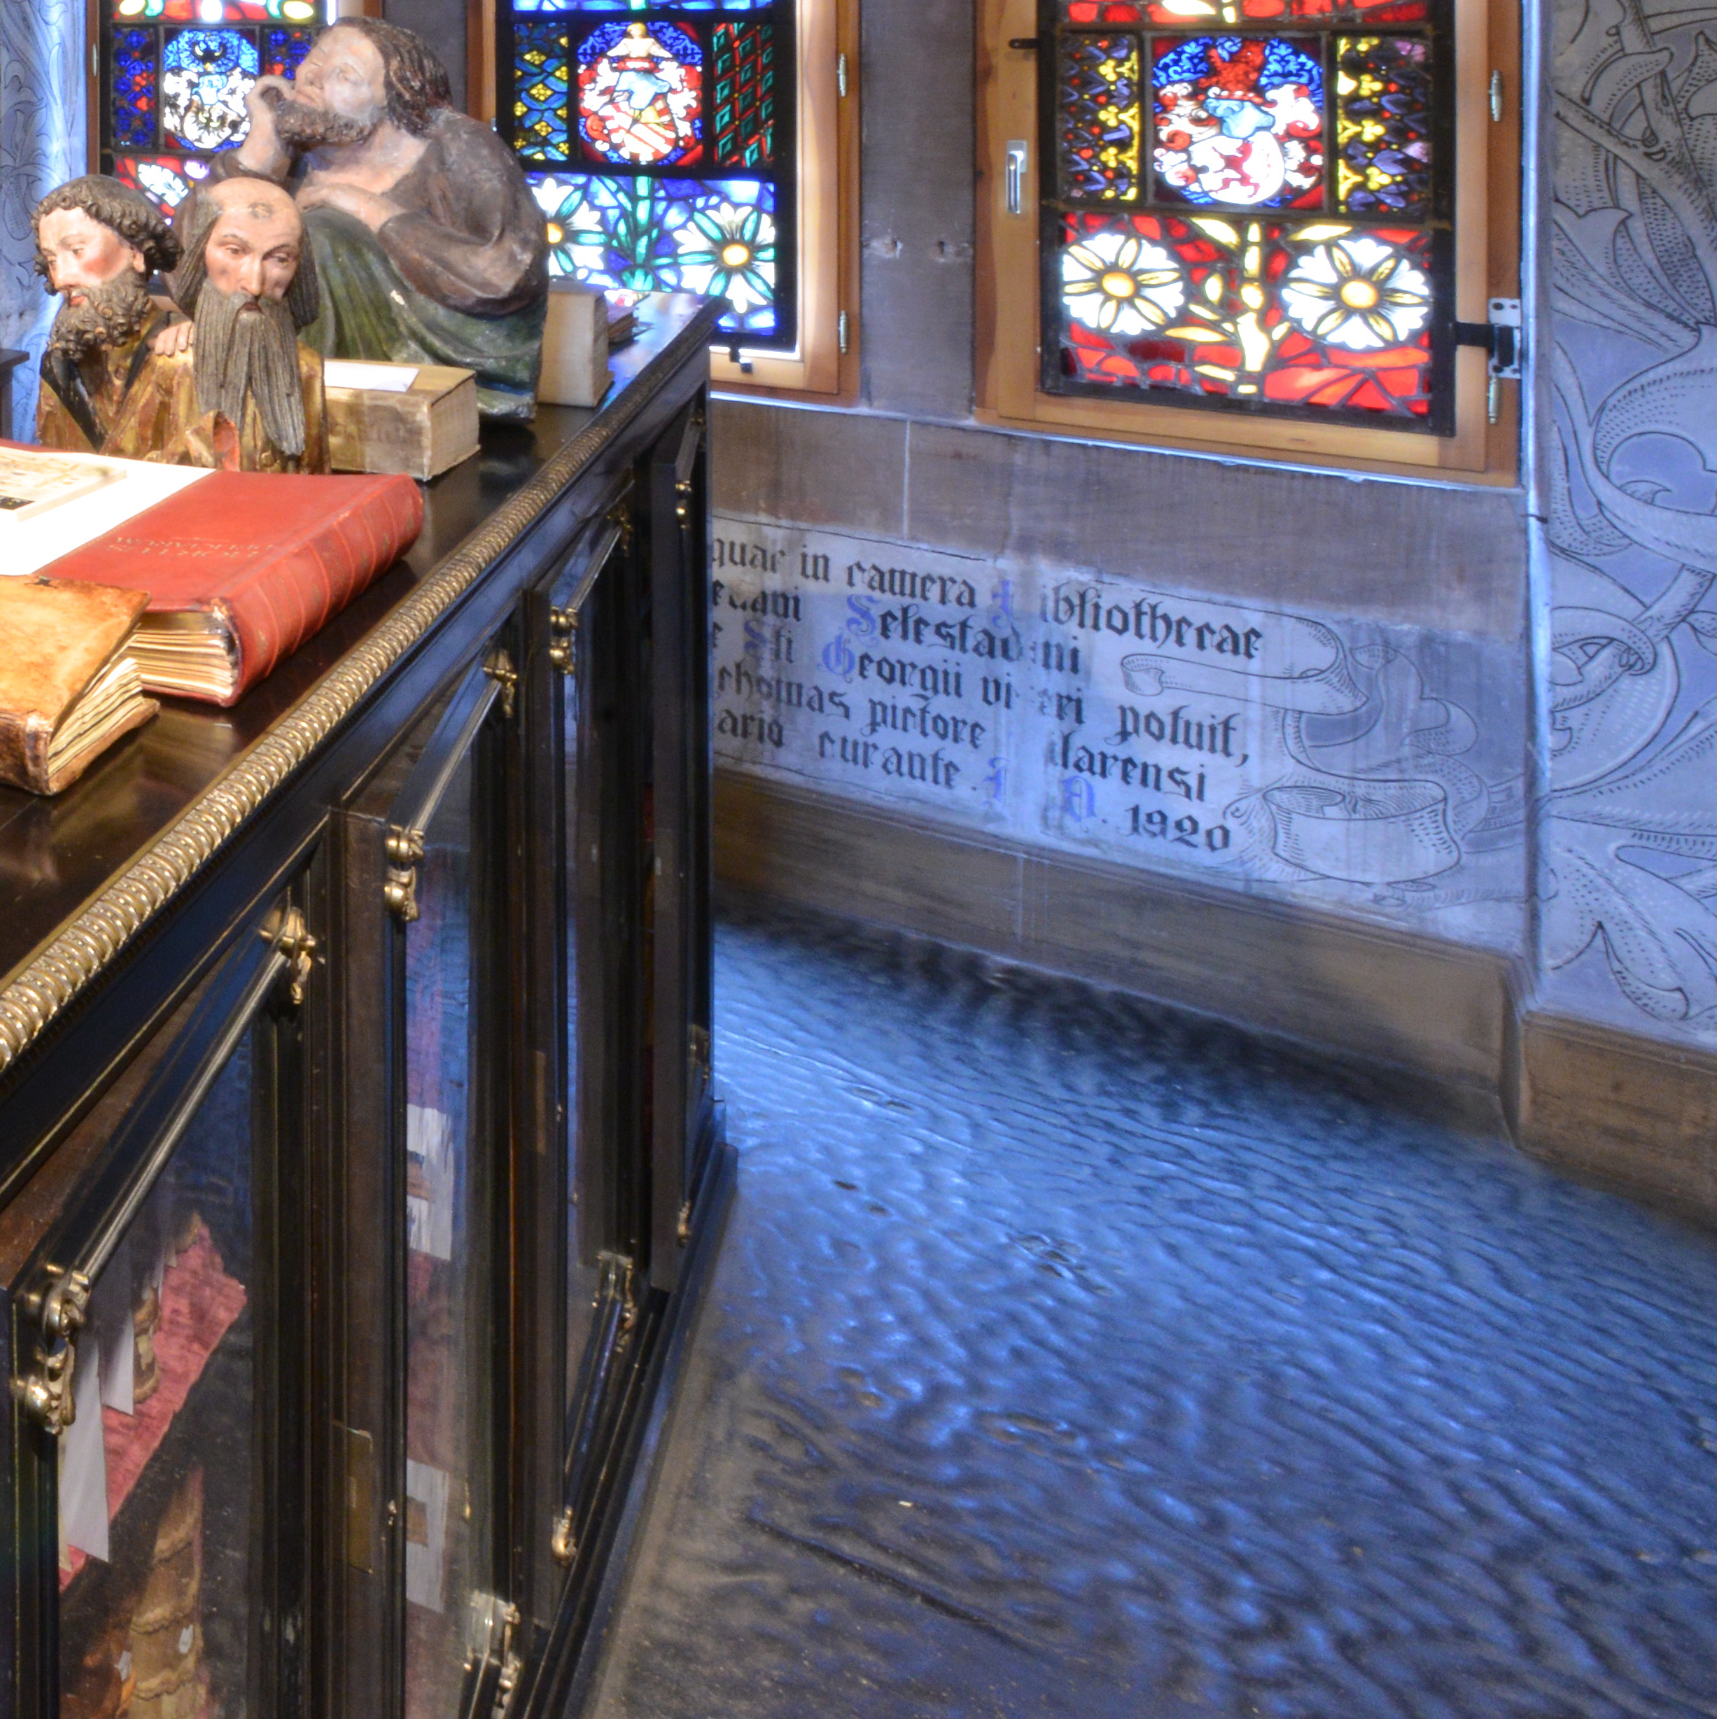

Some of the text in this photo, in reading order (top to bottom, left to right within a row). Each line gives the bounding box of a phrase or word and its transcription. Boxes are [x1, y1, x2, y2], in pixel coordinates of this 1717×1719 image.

[800, 544, 831, 582] in
[847, 561, 977, 608] camera
[1124, 803, 1231, 853] 1920
